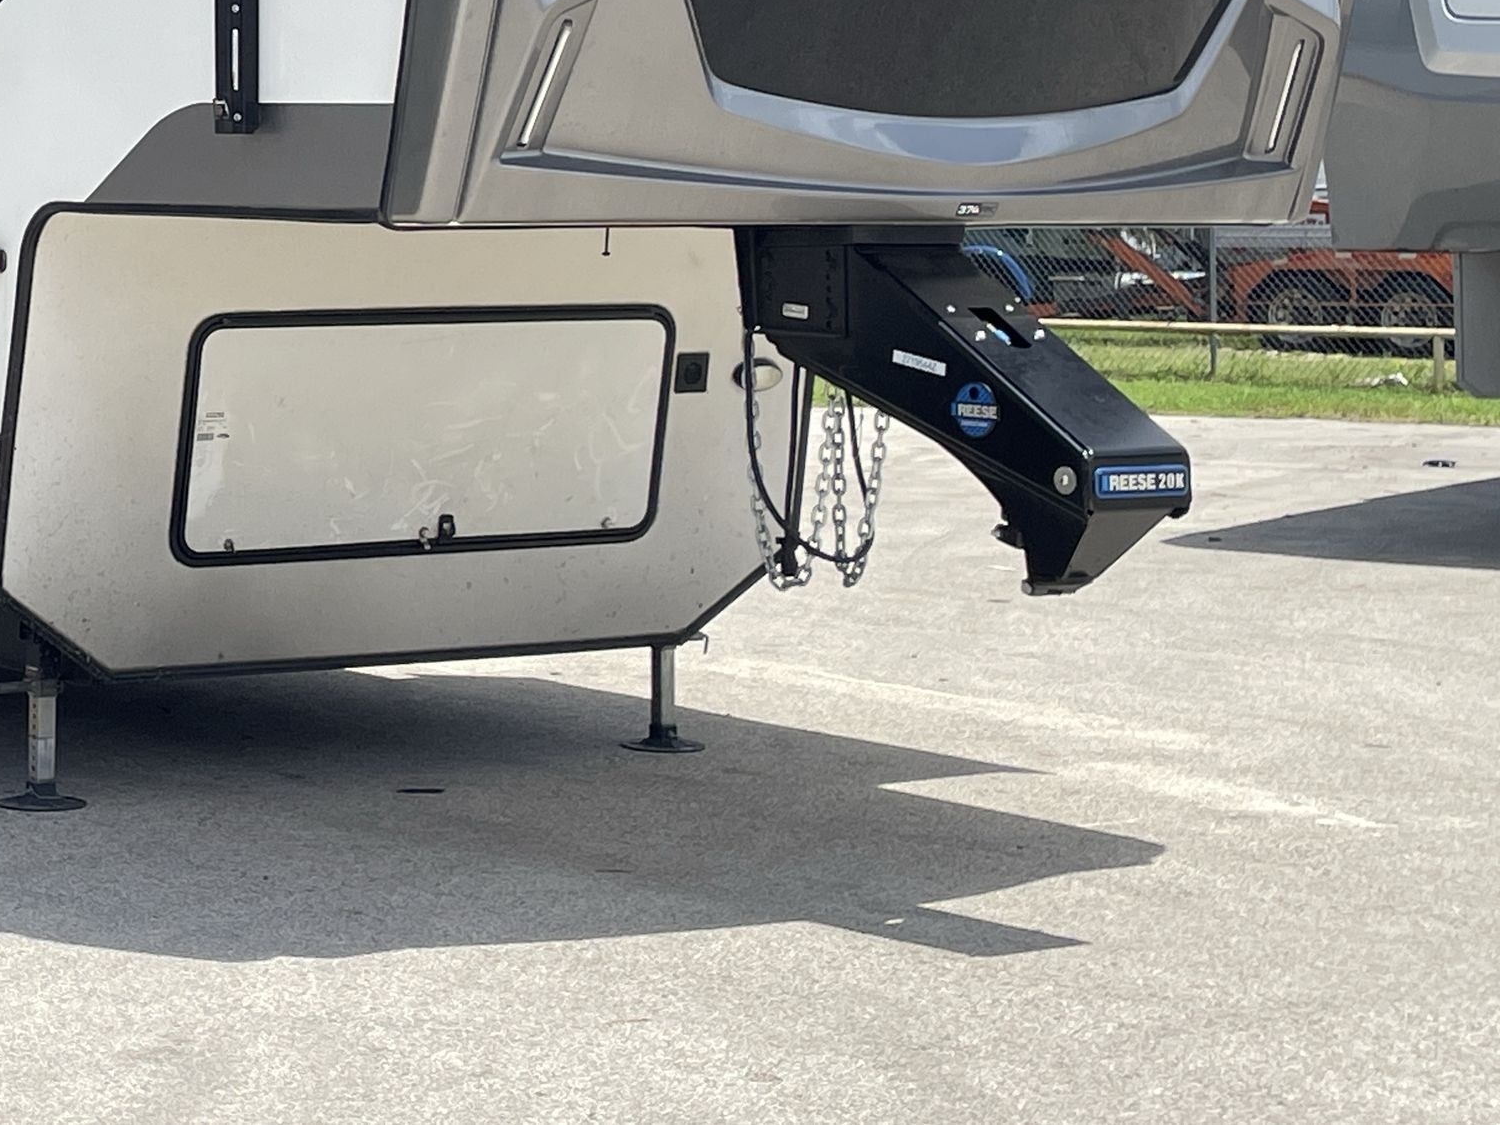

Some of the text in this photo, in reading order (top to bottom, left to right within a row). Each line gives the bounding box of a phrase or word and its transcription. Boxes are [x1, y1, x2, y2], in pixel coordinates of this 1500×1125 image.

[957, 403, 998, 420] REESE
[1109, 472, 1185, 492] REESE 20K
